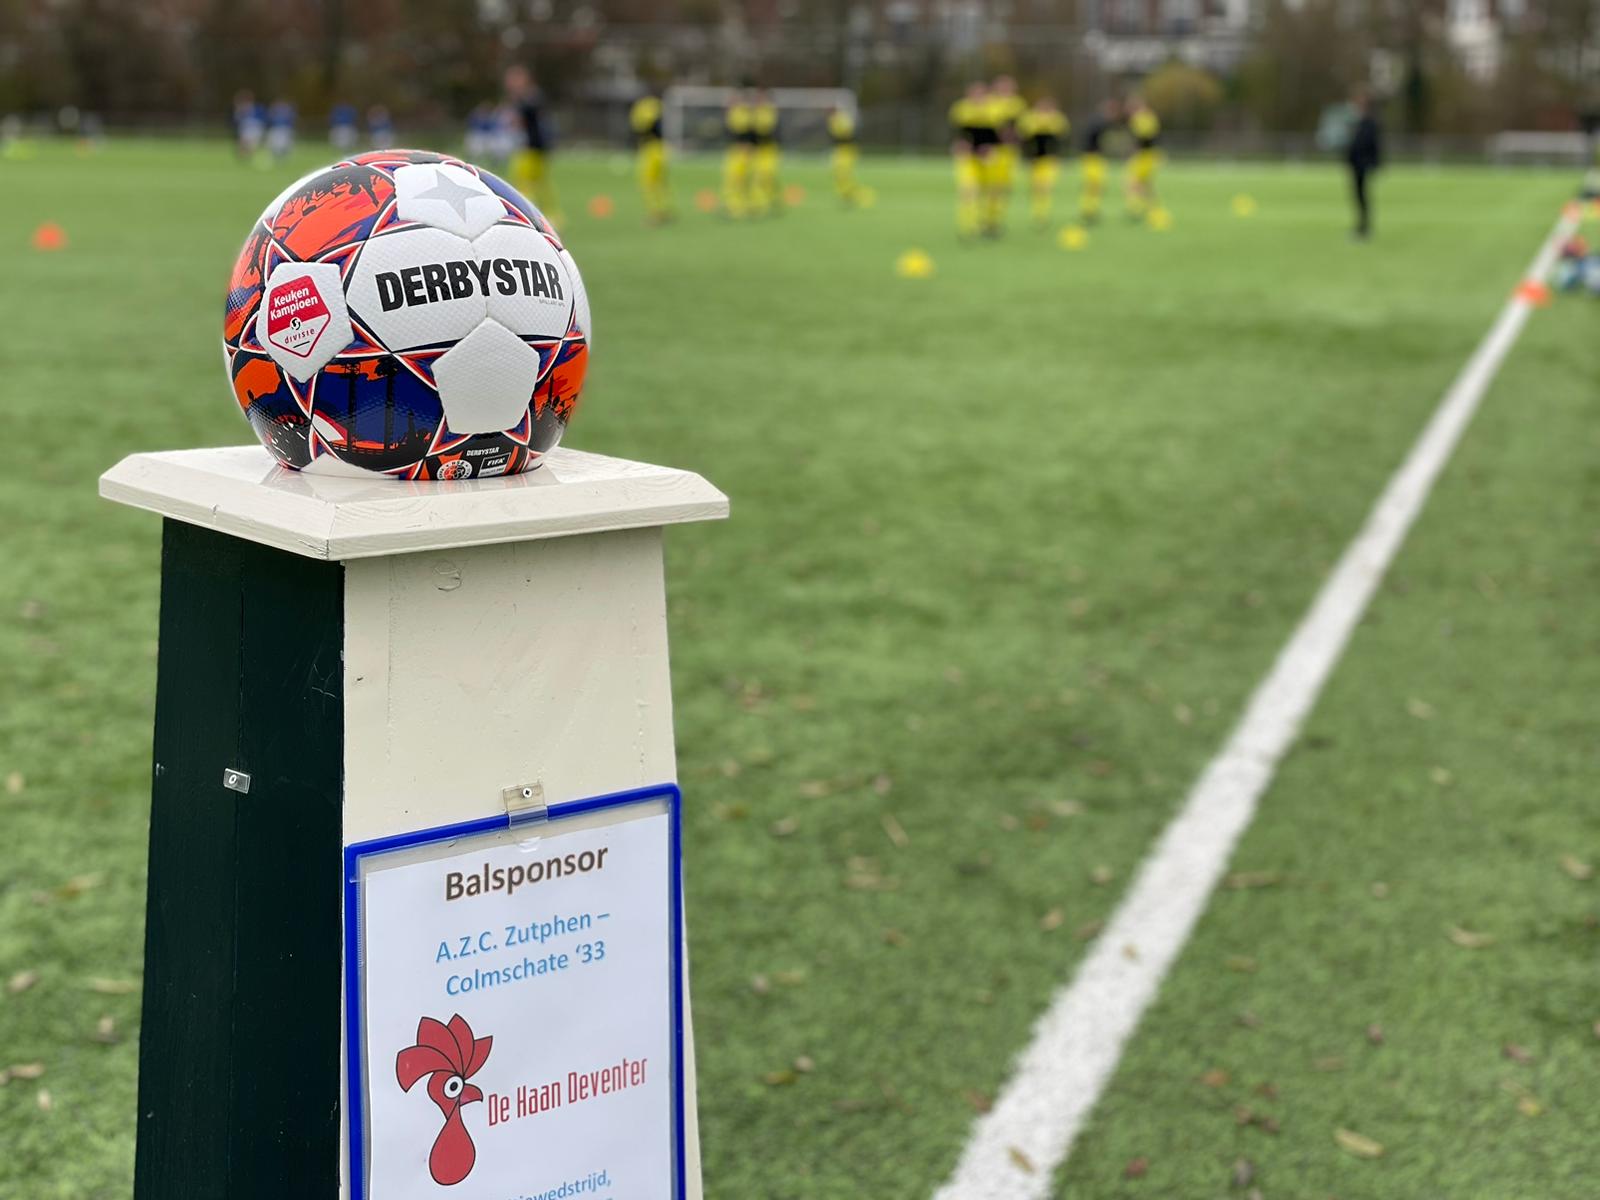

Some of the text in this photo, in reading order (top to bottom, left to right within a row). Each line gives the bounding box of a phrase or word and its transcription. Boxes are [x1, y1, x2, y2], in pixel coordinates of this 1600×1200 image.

[273, 287, 310, 308] Keuken
[375, 258, 564, 312] DERBYSTAR
[270, 296, 319, 321] Kampioen
[466, 447, 500, 456] DERBYSTAR
[445, 845, 608, 902] Balsponsor
[435, 930, 498, 963] A.Z.C.
[504, 912, 591, 951] Zutphen
[446, 954, 569, 996] Colmschate
[487, 1058, 648, 1127] De Haan Deventer
